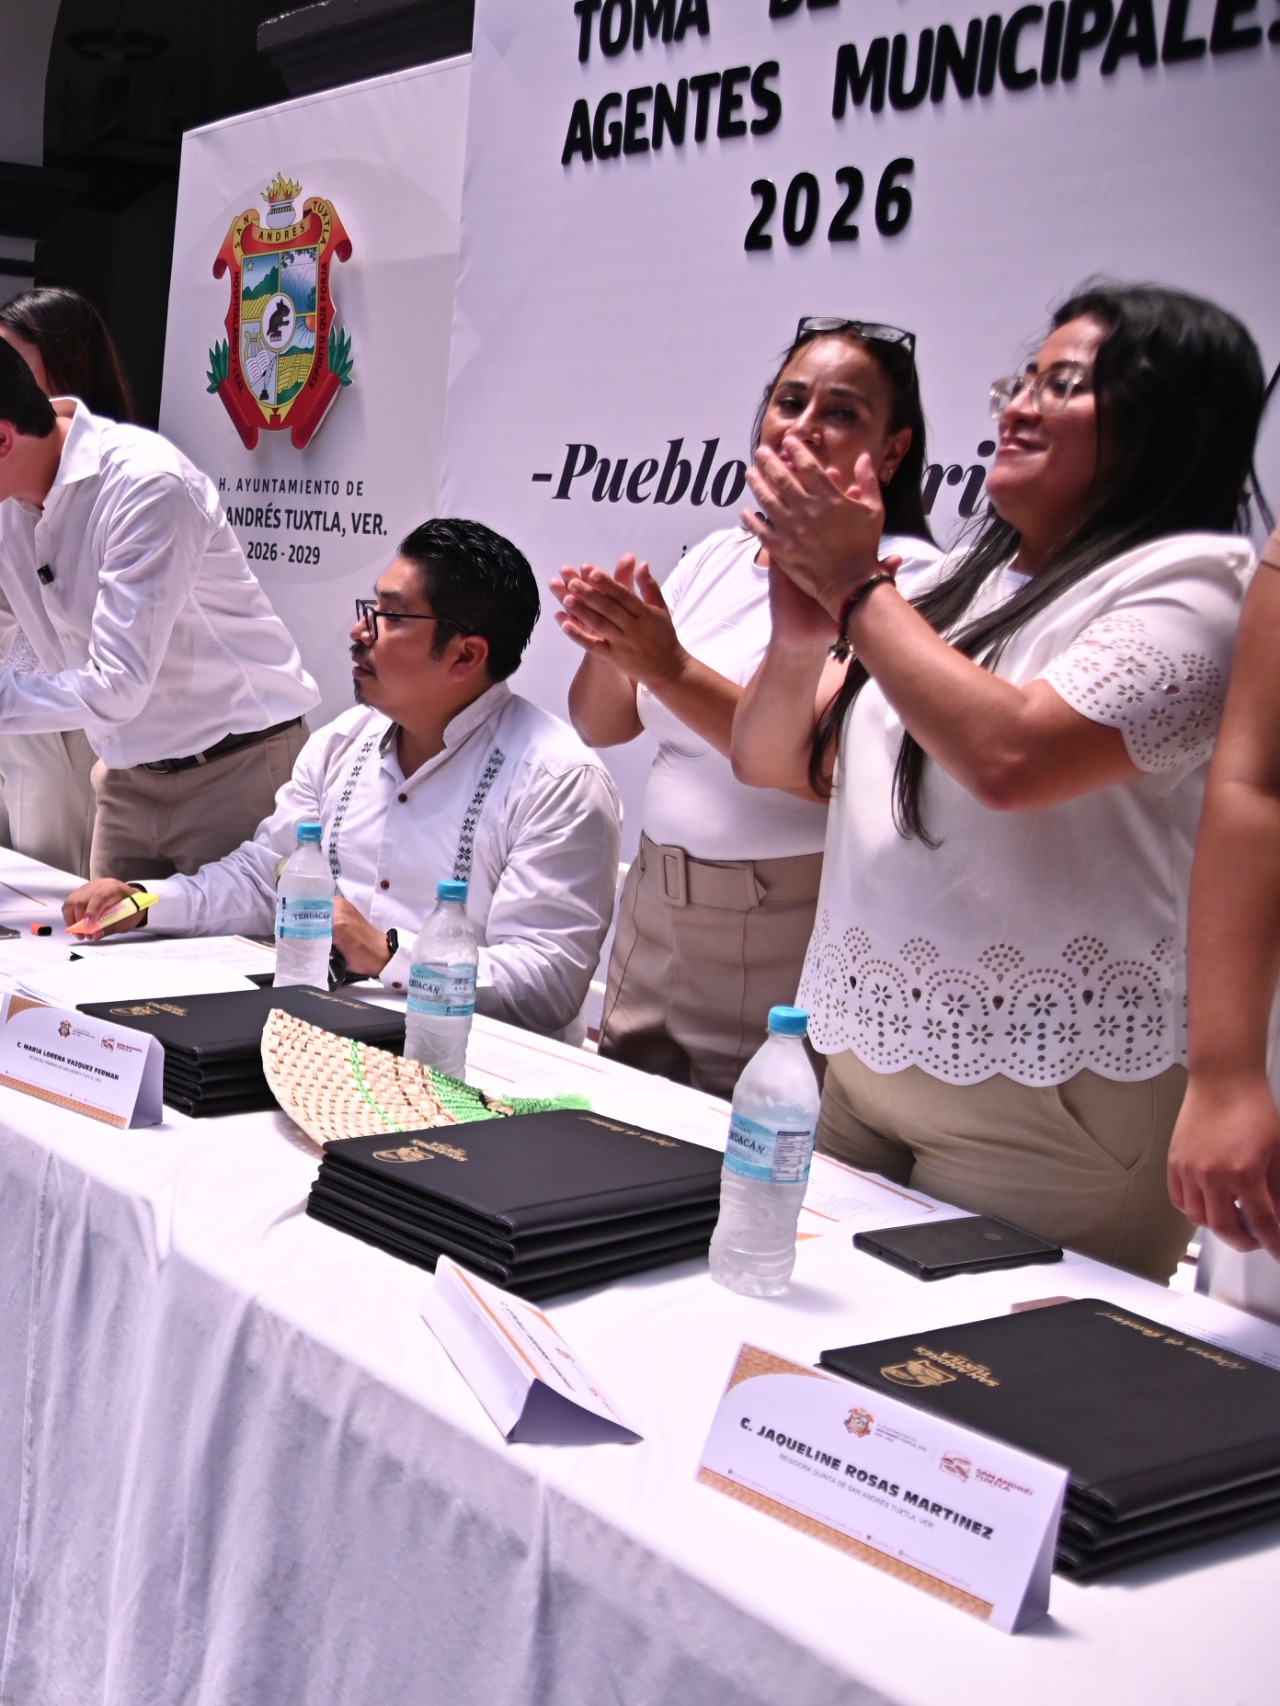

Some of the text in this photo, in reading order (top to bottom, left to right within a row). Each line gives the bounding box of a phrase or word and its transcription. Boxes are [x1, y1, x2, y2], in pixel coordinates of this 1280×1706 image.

[574, 0, 710, 63] TOMA
[562, 60, 782, 165] AGENTES
[312, 201, 331, 246] TUXTLA
[744, 158, 915, 252] 2026
[258, 223, 305, 243] ANDRES
[219, 478, 363, 497] H. AYUNTAMIENTO DE
[226, 503, 387, 537] ANDRÉS TUXTLA, VER.
[247, 541, 278, 561] 2026
[288, 544, 320, 565] 2029
[23, 1044, 42, 1055] MARIA
[43, 1050, 66, 1063] LORENA
[67, 1057, 93, 1073] VAZQUEZ
[94, 1068, 120, 1081] FERMAN
[740, 1417, 752, 1432] C.
[756, 1425, 842, 1471] JAQUELINE
[845, 1464, 900, 1497] ROSAS
[903, 1490, 994, 1540] MARTINEZ
[779, 1454, 812, 1473] REGIDORA
[812, 1469, 836, 1485] QUINTA
[836, 1480, 847, 1489] DE
[847, 1484, 861, 1496] SAN
[862, 1491, 889, 1509] ANDRÉS
